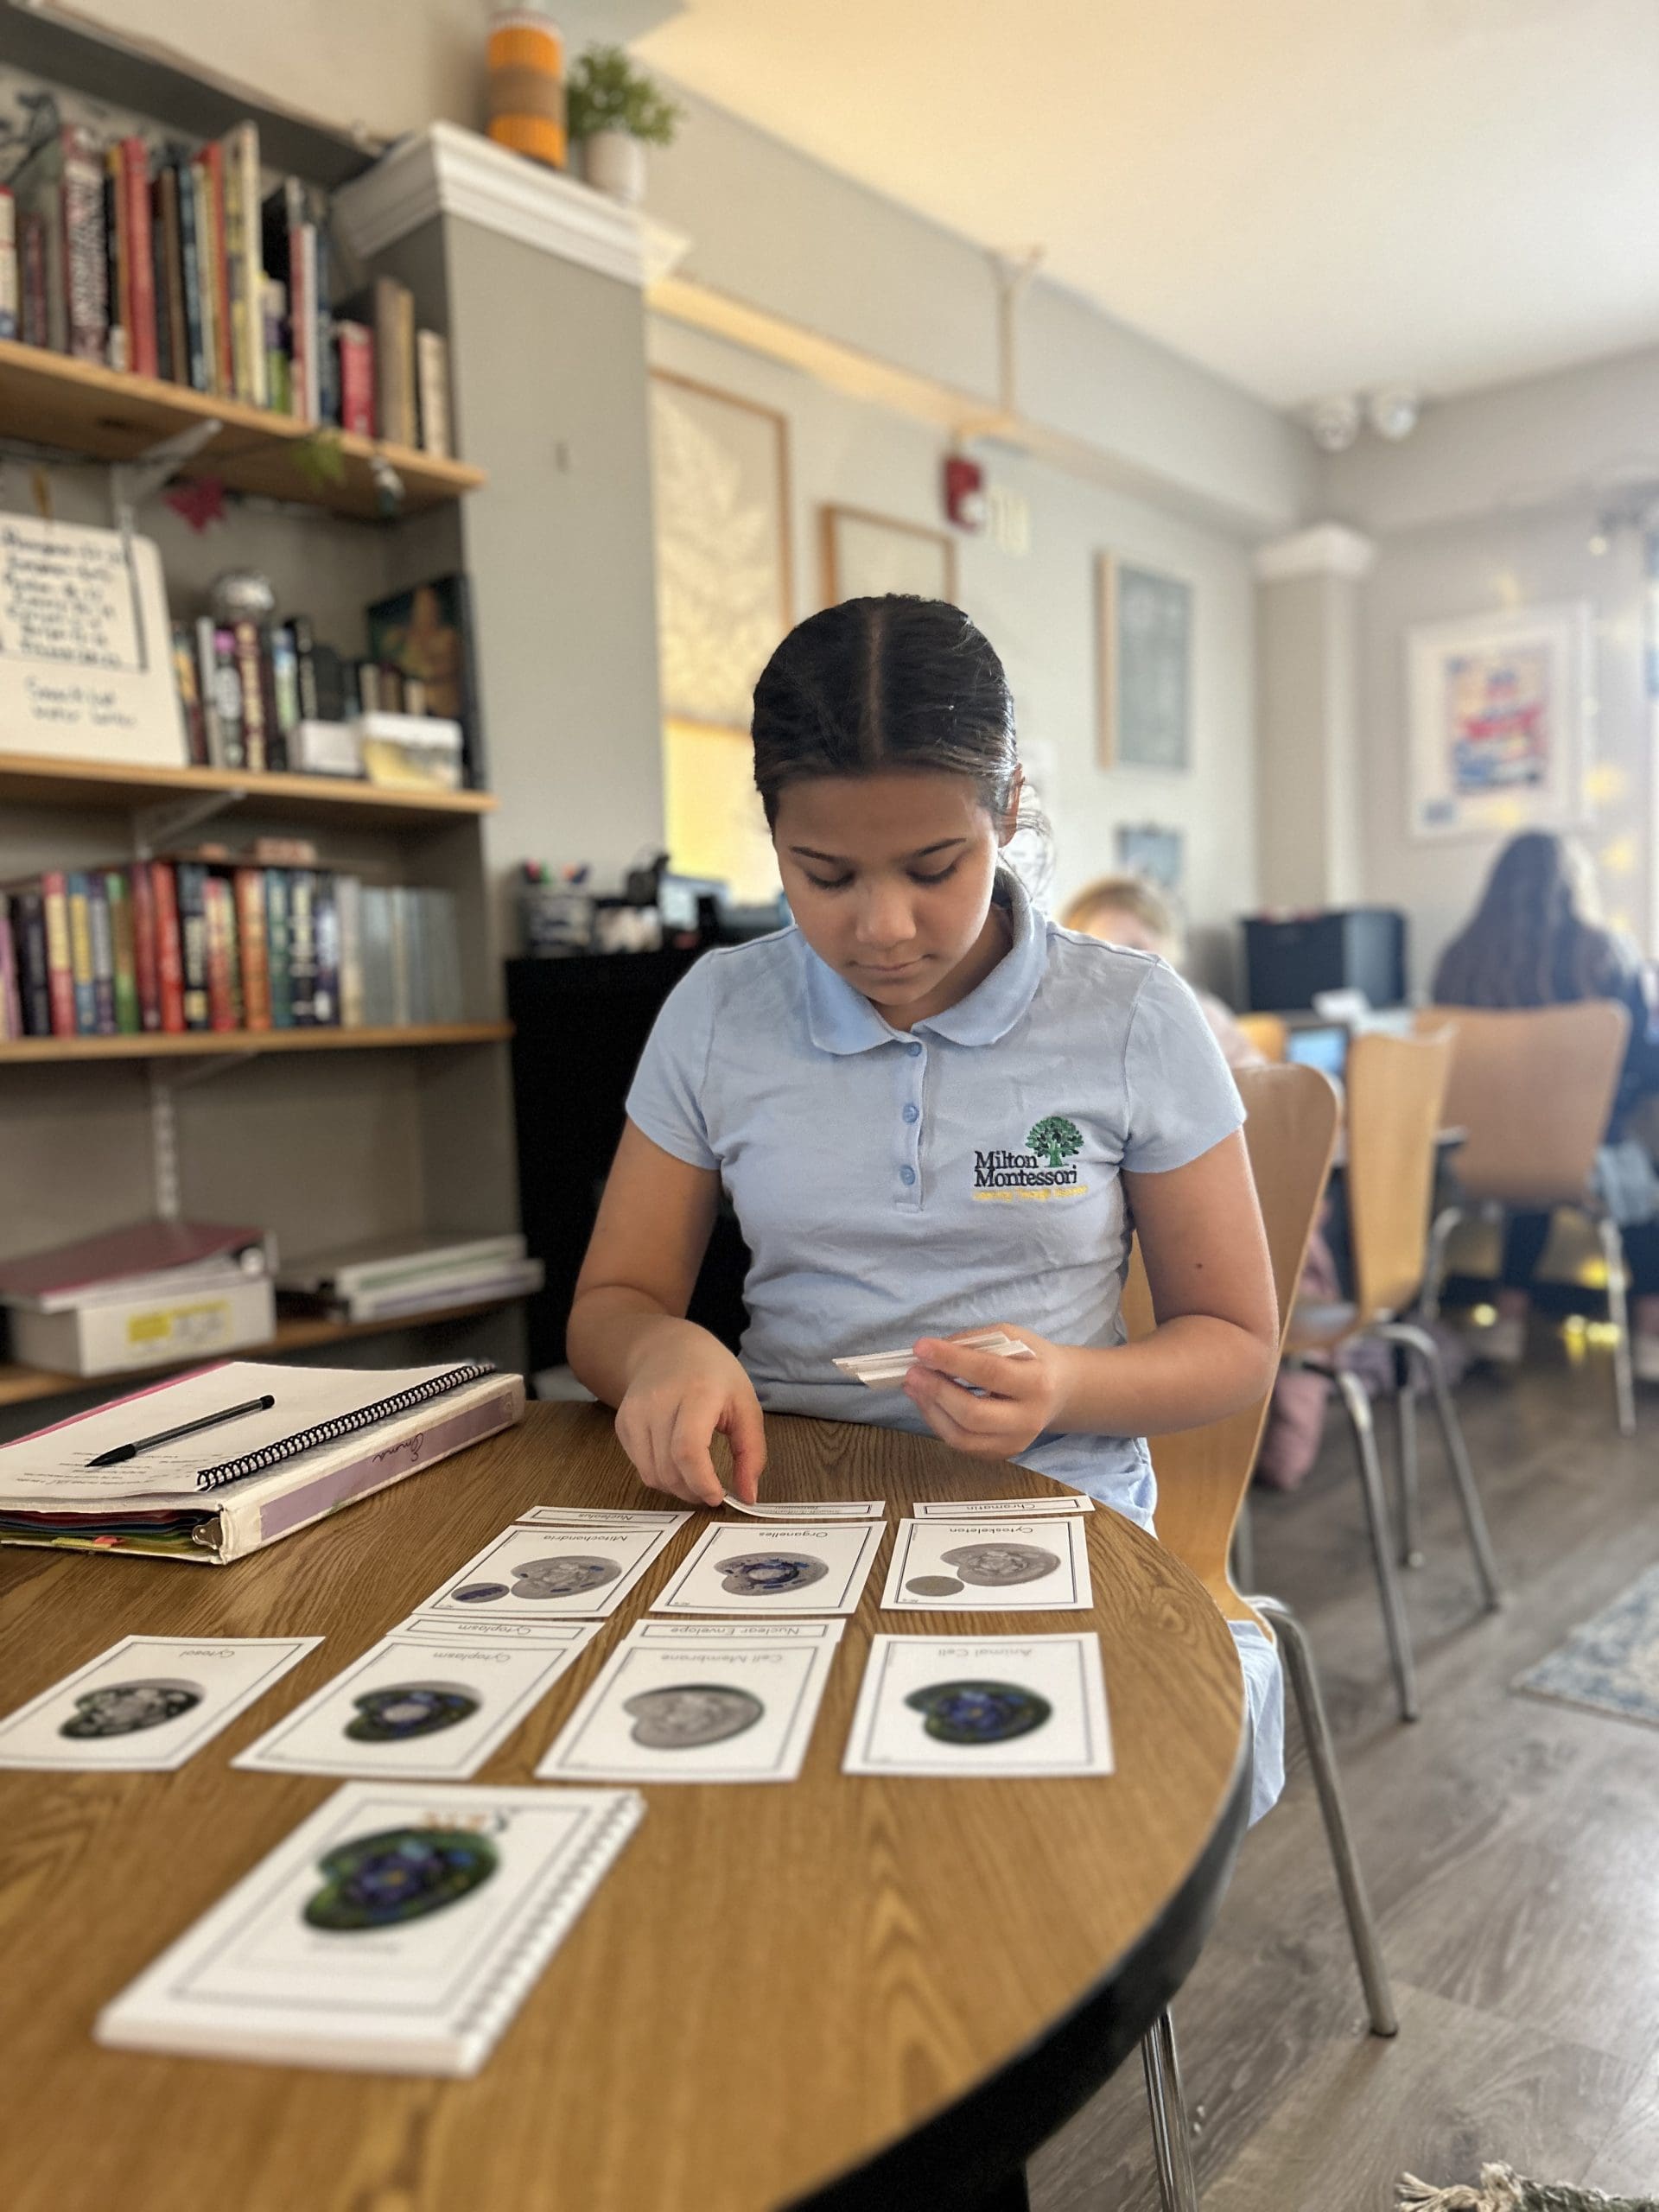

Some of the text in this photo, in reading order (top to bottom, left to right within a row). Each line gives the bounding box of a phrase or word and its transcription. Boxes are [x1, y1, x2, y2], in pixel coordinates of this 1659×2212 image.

[974, 1151, 1039, 1170] Milton
[974, 1165, 1077, 1187] Montessori
[966, 1503, 1035, 1511] Chromatin
[458, 1624, 531, 1636] Cytoplasm
[670, 1626, 800, 1636] Nuclear Envelope
[433, 1652, 511, 1663] Cytoplasm
[938, 1648, 1033, 1657] Animal Cell
[660, 1654, 783, 1663] Cell Membrane
